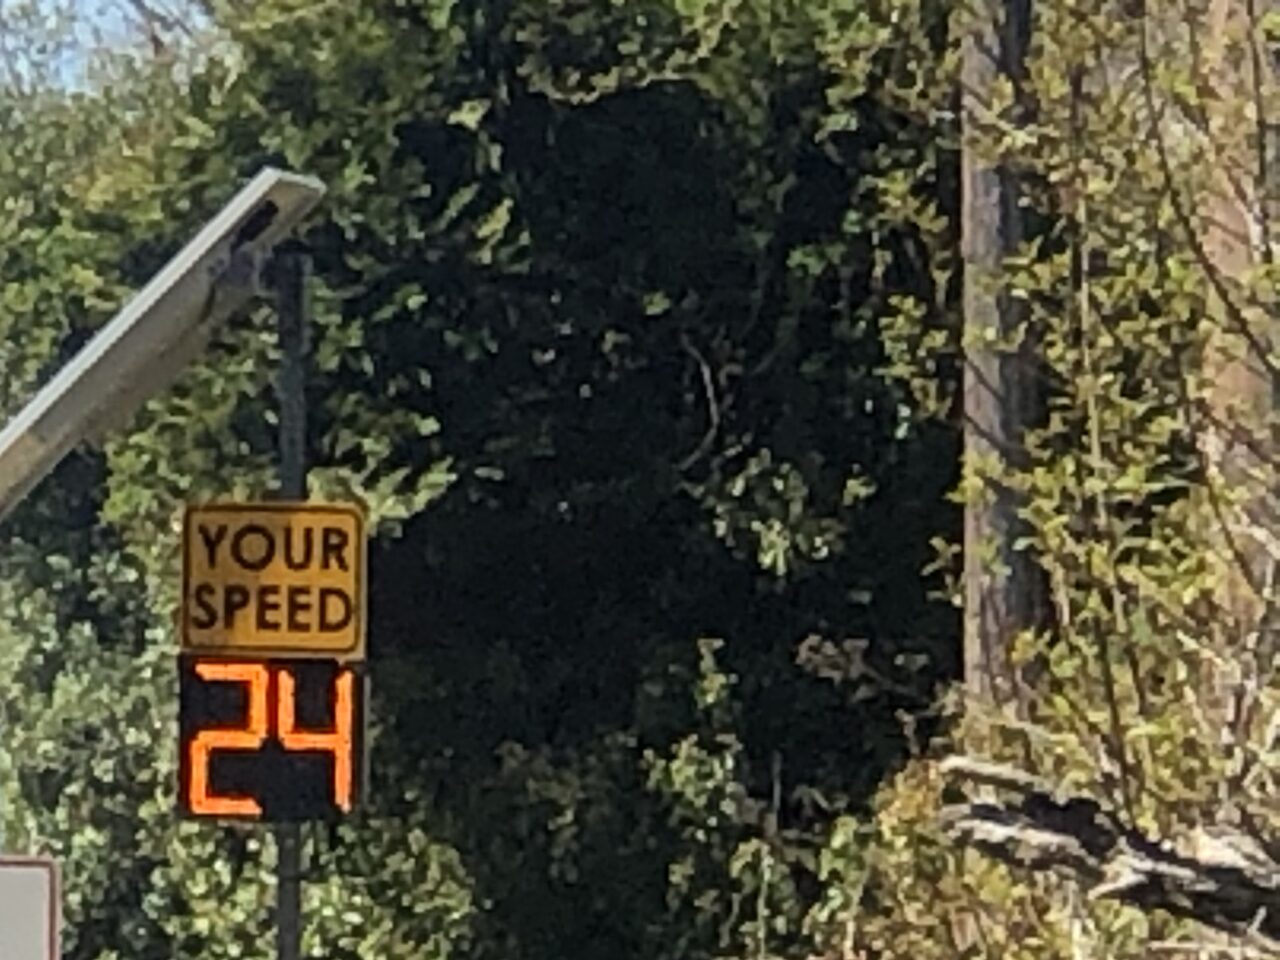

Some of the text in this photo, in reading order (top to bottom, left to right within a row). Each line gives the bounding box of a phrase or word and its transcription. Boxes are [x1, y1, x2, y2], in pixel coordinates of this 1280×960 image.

[197, 523, 349, 572] YOUR
[191, 582, 352, 633] SPEED
[188, 662, 353, 815] 24
